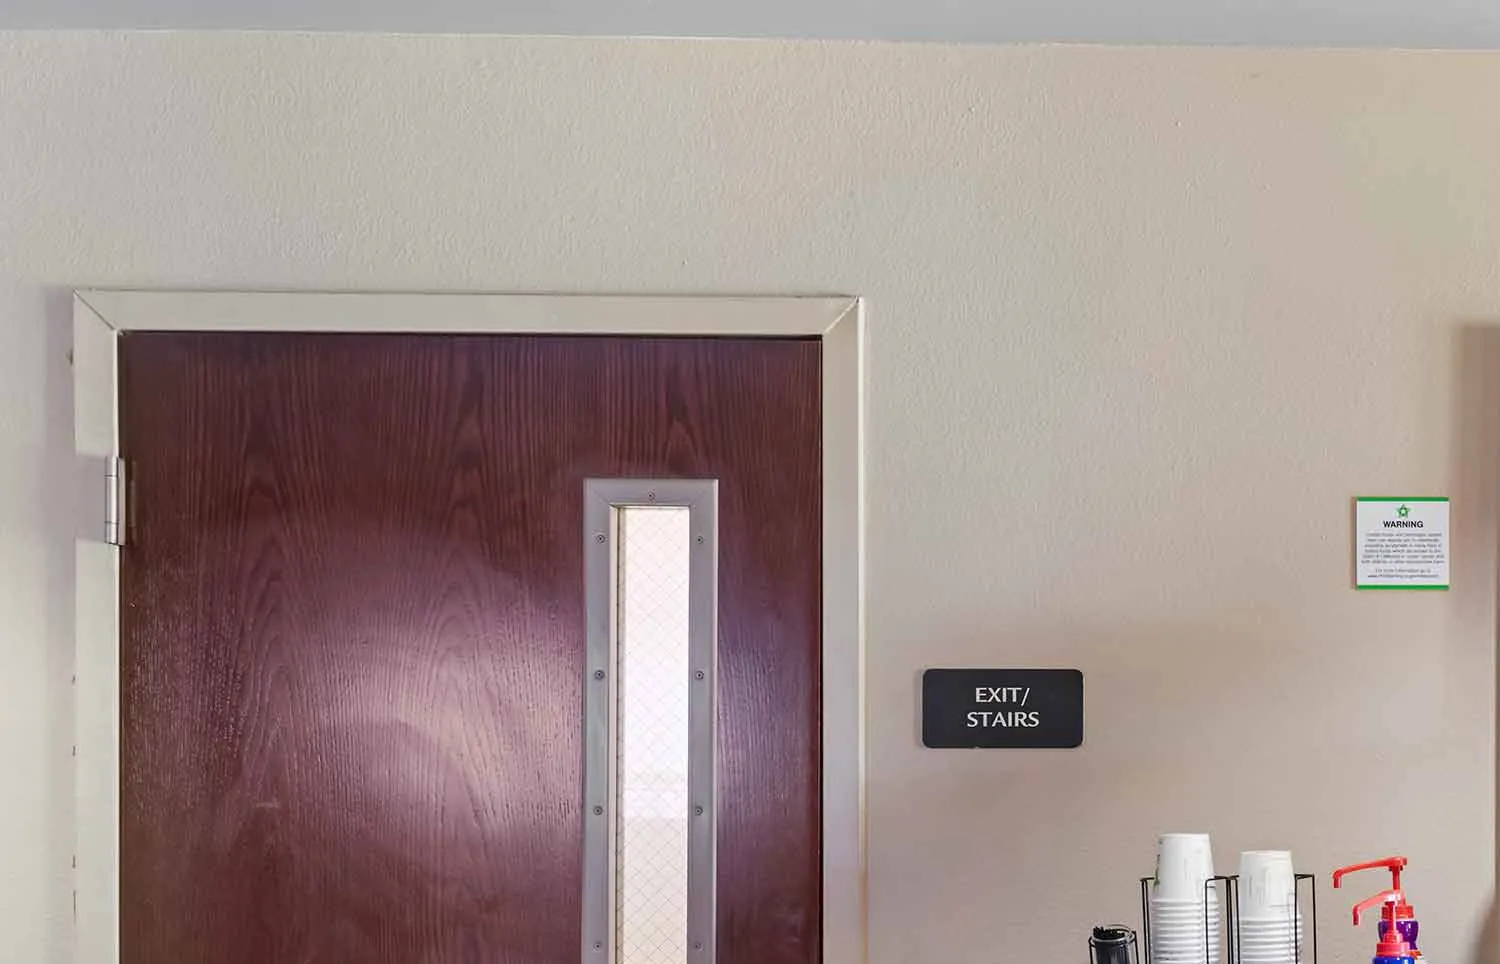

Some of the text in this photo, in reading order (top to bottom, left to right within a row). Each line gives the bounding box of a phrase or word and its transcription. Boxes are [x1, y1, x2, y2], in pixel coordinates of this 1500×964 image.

[1383, 520, 1424, 528] WARNING
[975, 687, 1030, 706] EXIT/
[966, 711, 1041, 728] STAIRS
